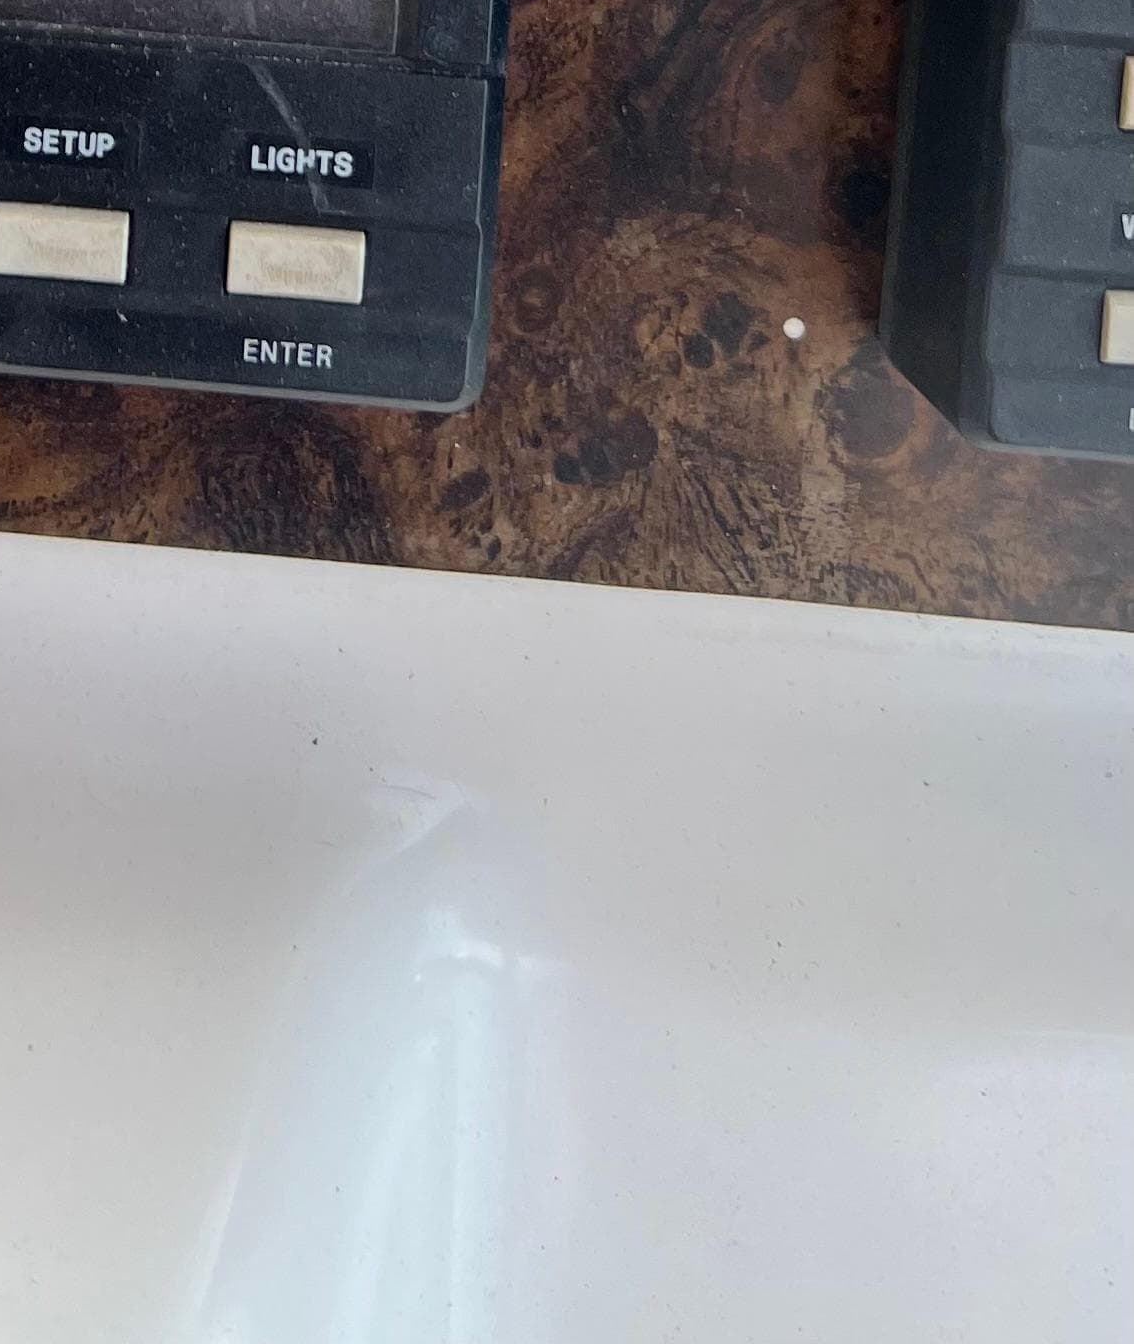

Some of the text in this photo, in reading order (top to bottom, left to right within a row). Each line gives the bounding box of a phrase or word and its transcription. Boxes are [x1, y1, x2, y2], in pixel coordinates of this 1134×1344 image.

[23, 126, 115, 158] SETUP
[251, 144, 353, 177] LIGHTS
[243, 338, 333, 369] ENTER
